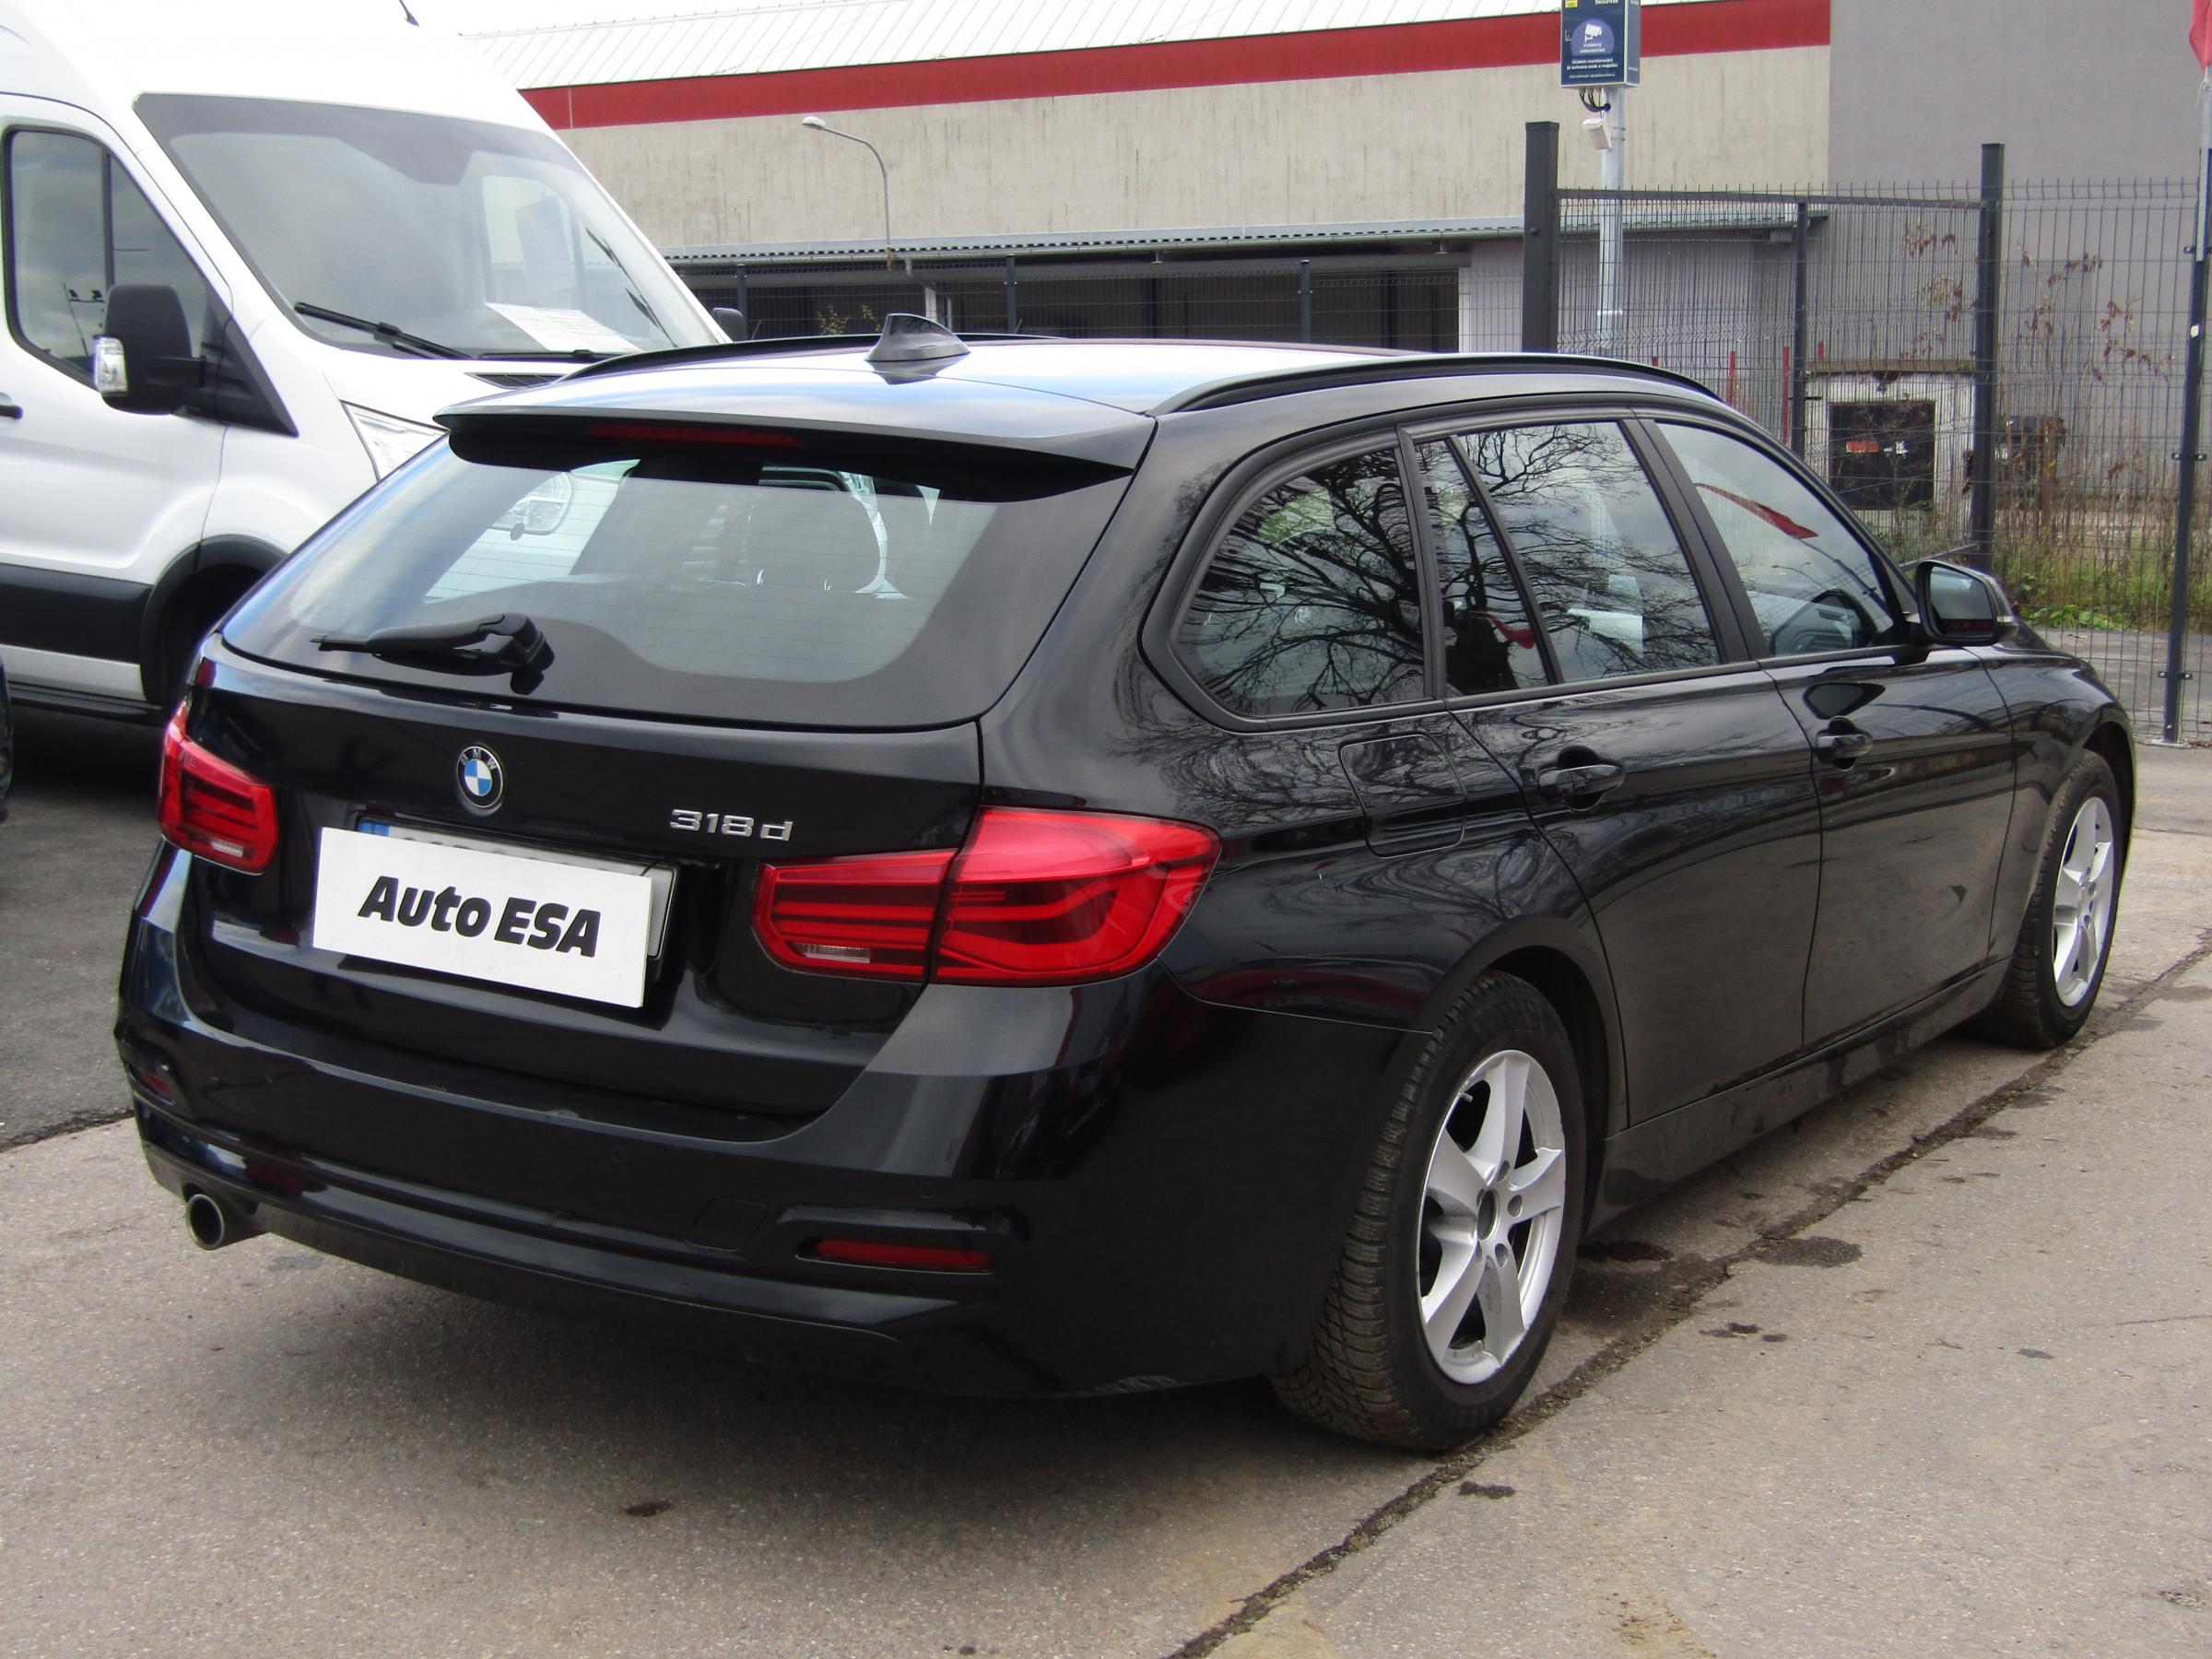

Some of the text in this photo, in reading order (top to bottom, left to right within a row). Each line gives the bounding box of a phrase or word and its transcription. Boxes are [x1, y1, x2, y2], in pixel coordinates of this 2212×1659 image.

[461, 748, 498, 771] BMW
[358, 876, 601, 958] Auto ESA
